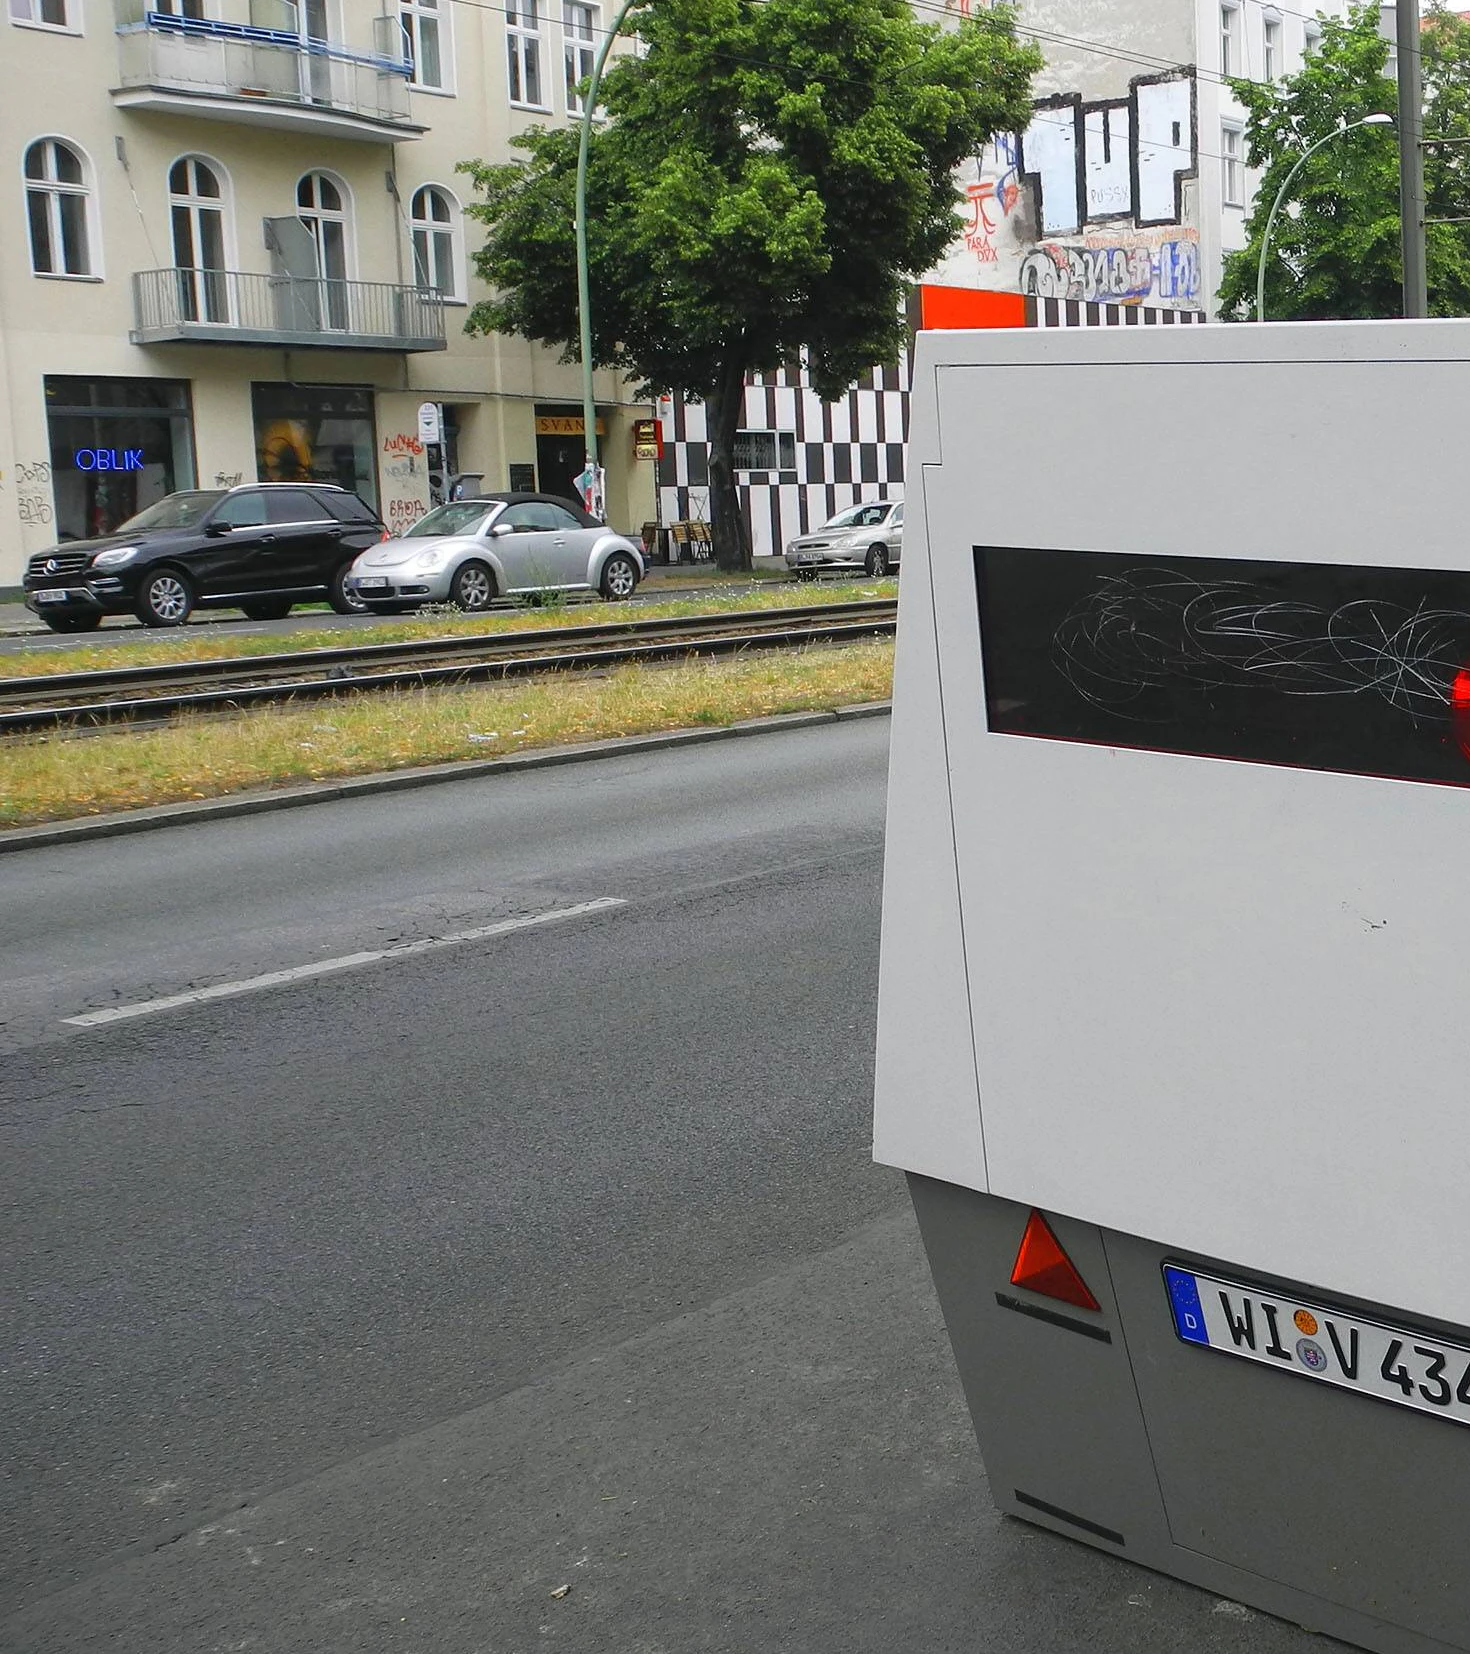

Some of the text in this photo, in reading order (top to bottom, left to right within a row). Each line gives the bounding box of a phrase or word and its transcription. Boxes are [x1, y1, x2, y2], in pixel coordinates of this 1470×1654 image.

[76, 448, 145, 471] OBLIK
[1184, 1312, 1198, 1330] D
[1218, 1290, 1292, 1361] WI
[1324, 1320, 1359, 1380] V
